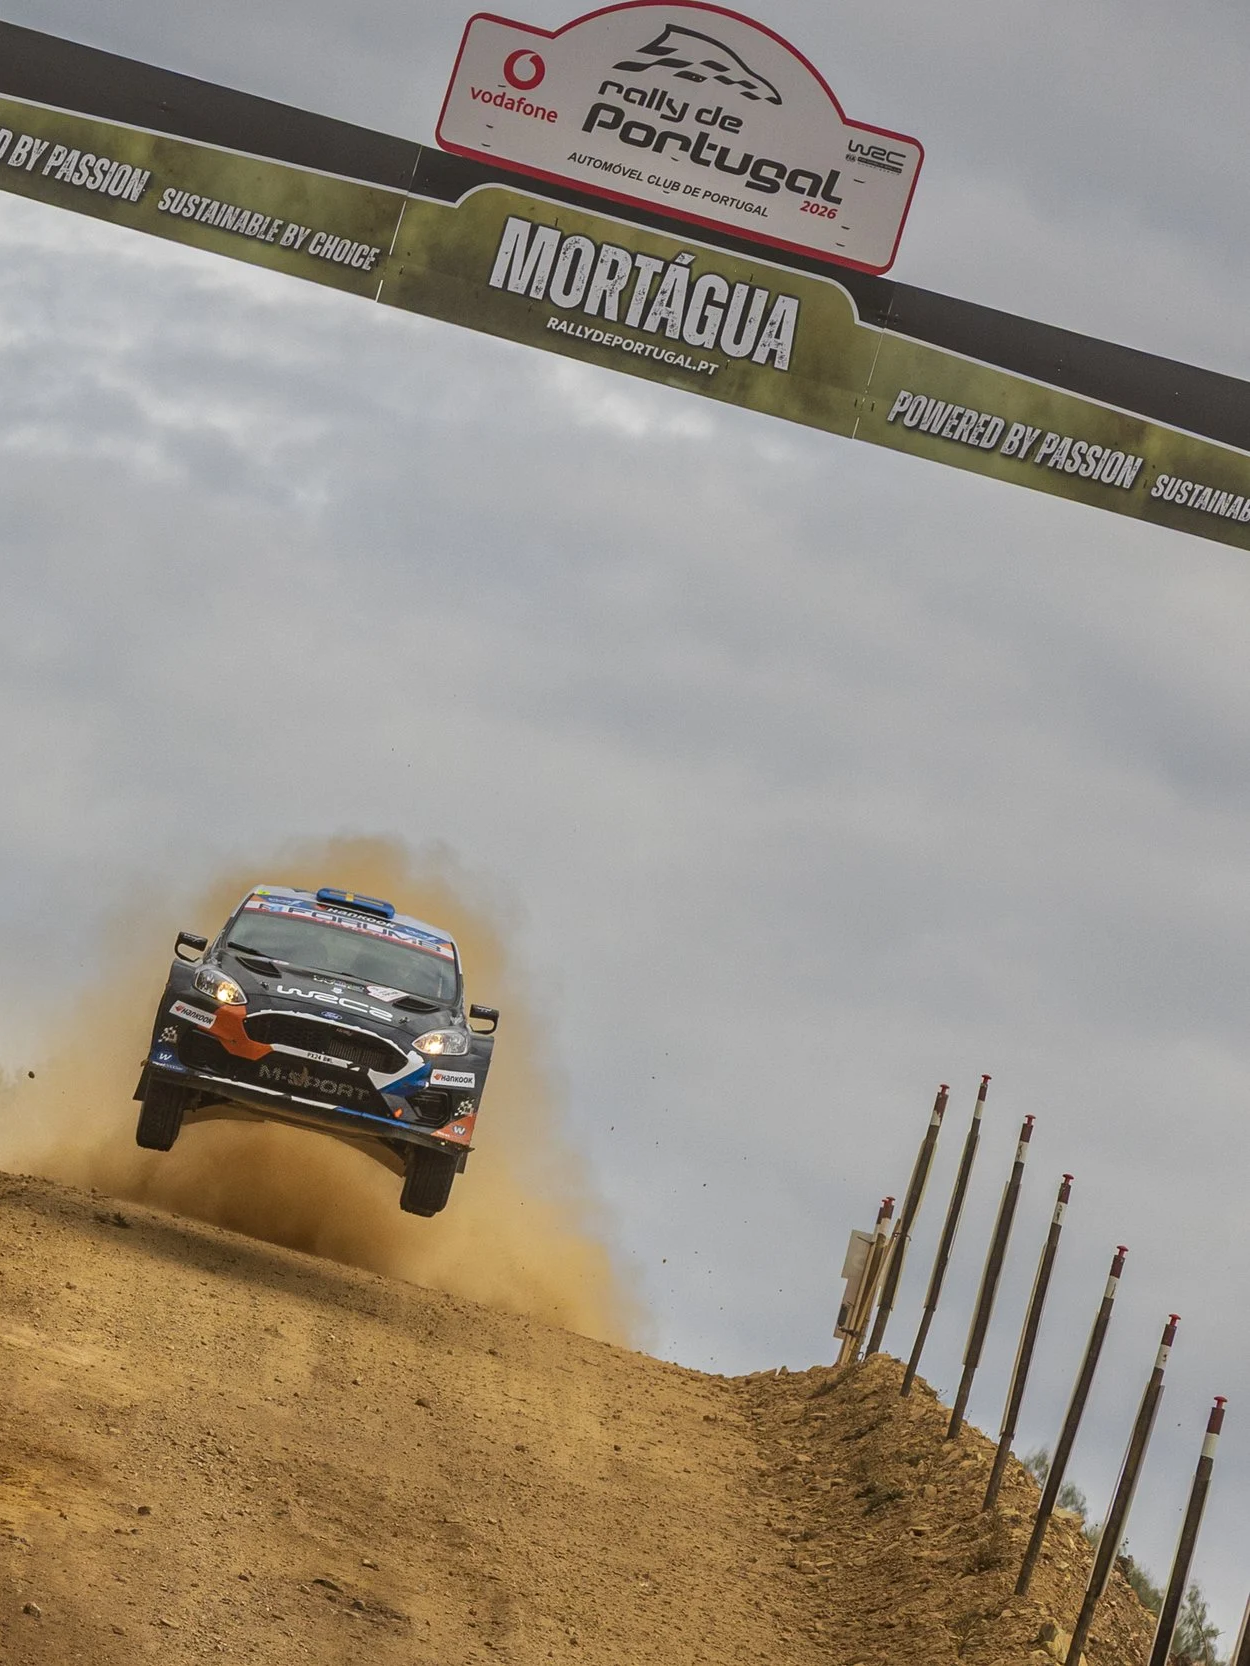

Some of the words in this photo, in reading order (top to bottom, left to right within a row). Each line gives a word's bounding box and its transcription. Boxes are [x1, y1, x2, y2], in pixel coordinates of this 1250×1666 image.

[469, 85, 559, 124] vodafone
[597, 78, 690, 123] rally
[694, 104, 745, 135] de
[7, 134, 50, 176] BY
[44, 145, 151, 202] PASSION
[581, 101, 843, 204] Portugal
[847, 139, 907, 167] WRC
[566, 151, 645, 182] AUTOMÓVEL
[646, 174, 682, 193] CLUB
[681, 183, 702, 199] DE
[701, 188, 770, 219] PORTUGAL
[798, 200, 839, 220] 2026
[156, 187, 284, 243] SUSTAINABLE
[279, 220, 312, 250] BY
[307, 231, 382, 272] CHOICE
[488, 216, 800, 372] MORTÁGUA
[546, 317, 720, 377] RALLYDEPORTUGAL.PT
[887, 390, 1006, 450] POWERED
[1000, 421, 1042, 457] BY
[1033, 432, 1144, 490] PASSION
[276, 985, 394, 1022] WRC2
